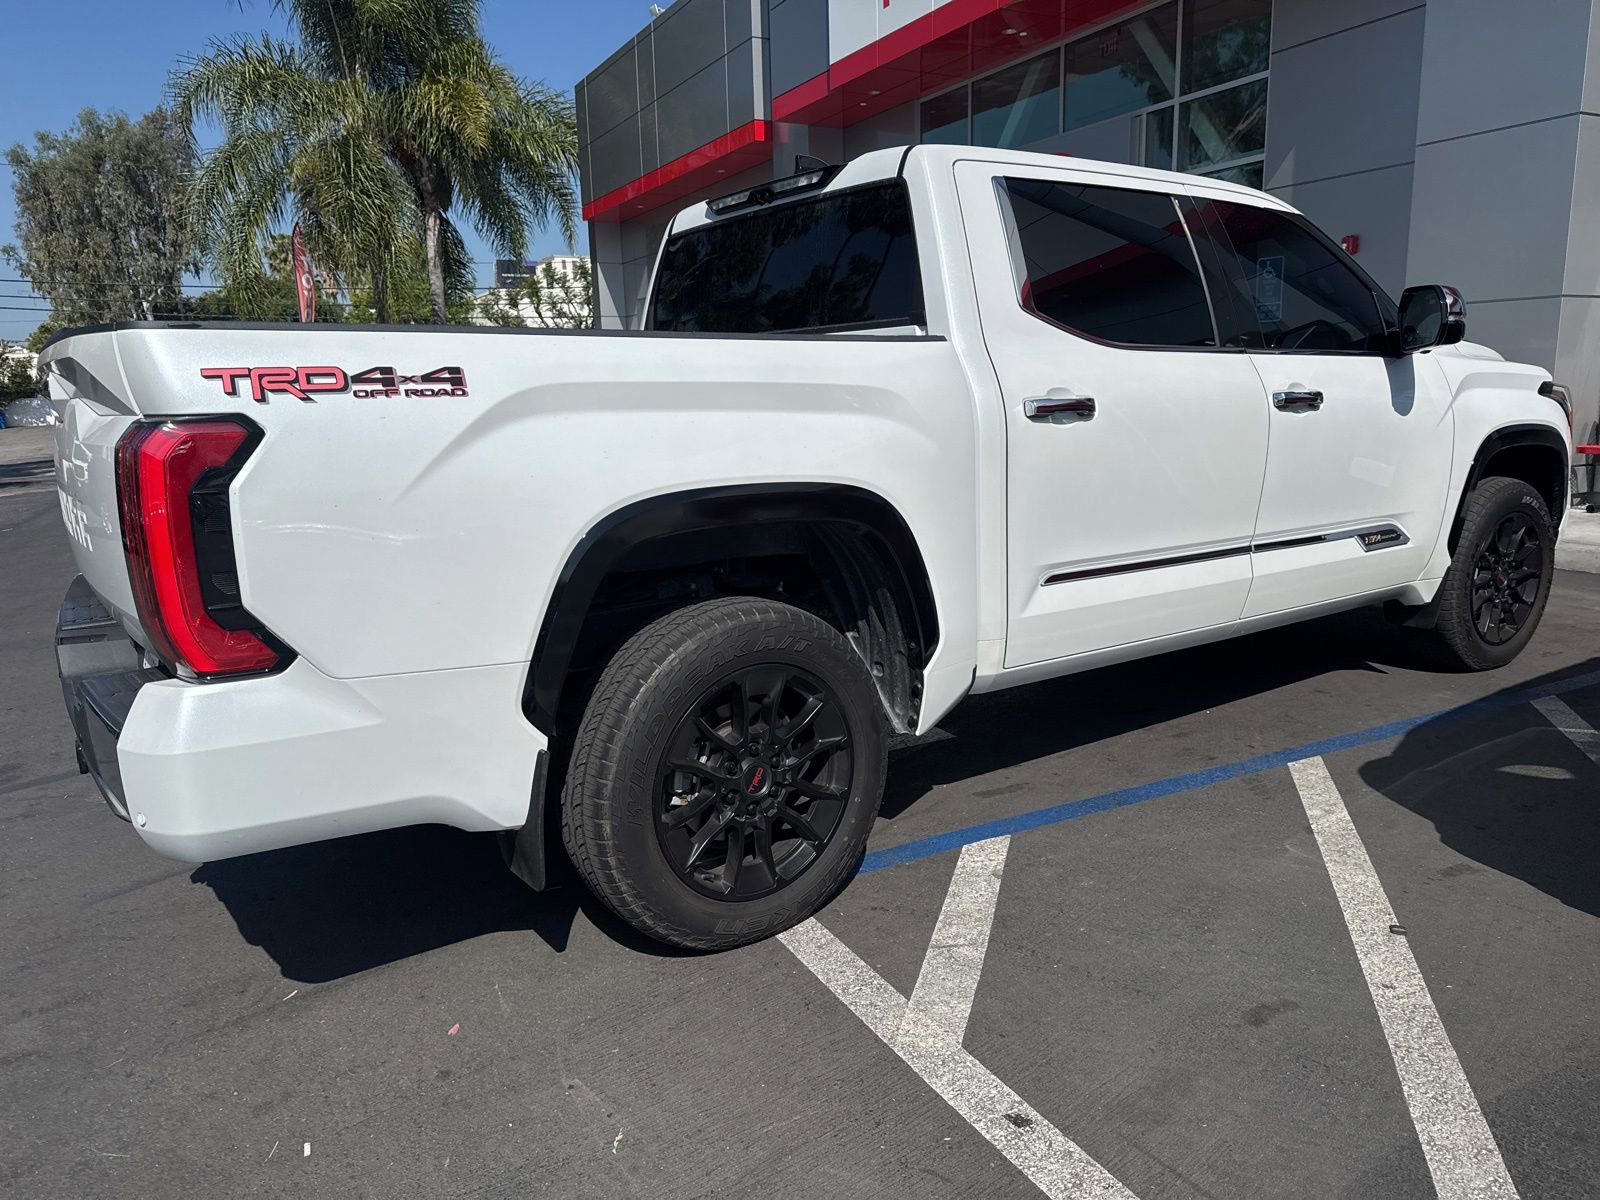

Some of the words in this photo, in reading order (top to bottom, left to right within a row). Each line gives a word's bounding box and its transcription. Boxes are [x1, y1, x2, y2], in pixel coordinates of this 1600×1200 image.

[200, 366, 351, 403] TRD
[352, 388, 401, 399] OFF
[404, 387, 468, 398] ROAD
[626, 639, 752, 827] WILDPEAK
[752, 633, 813, 653] A/T
[747, 766, 764, 793] TRD
